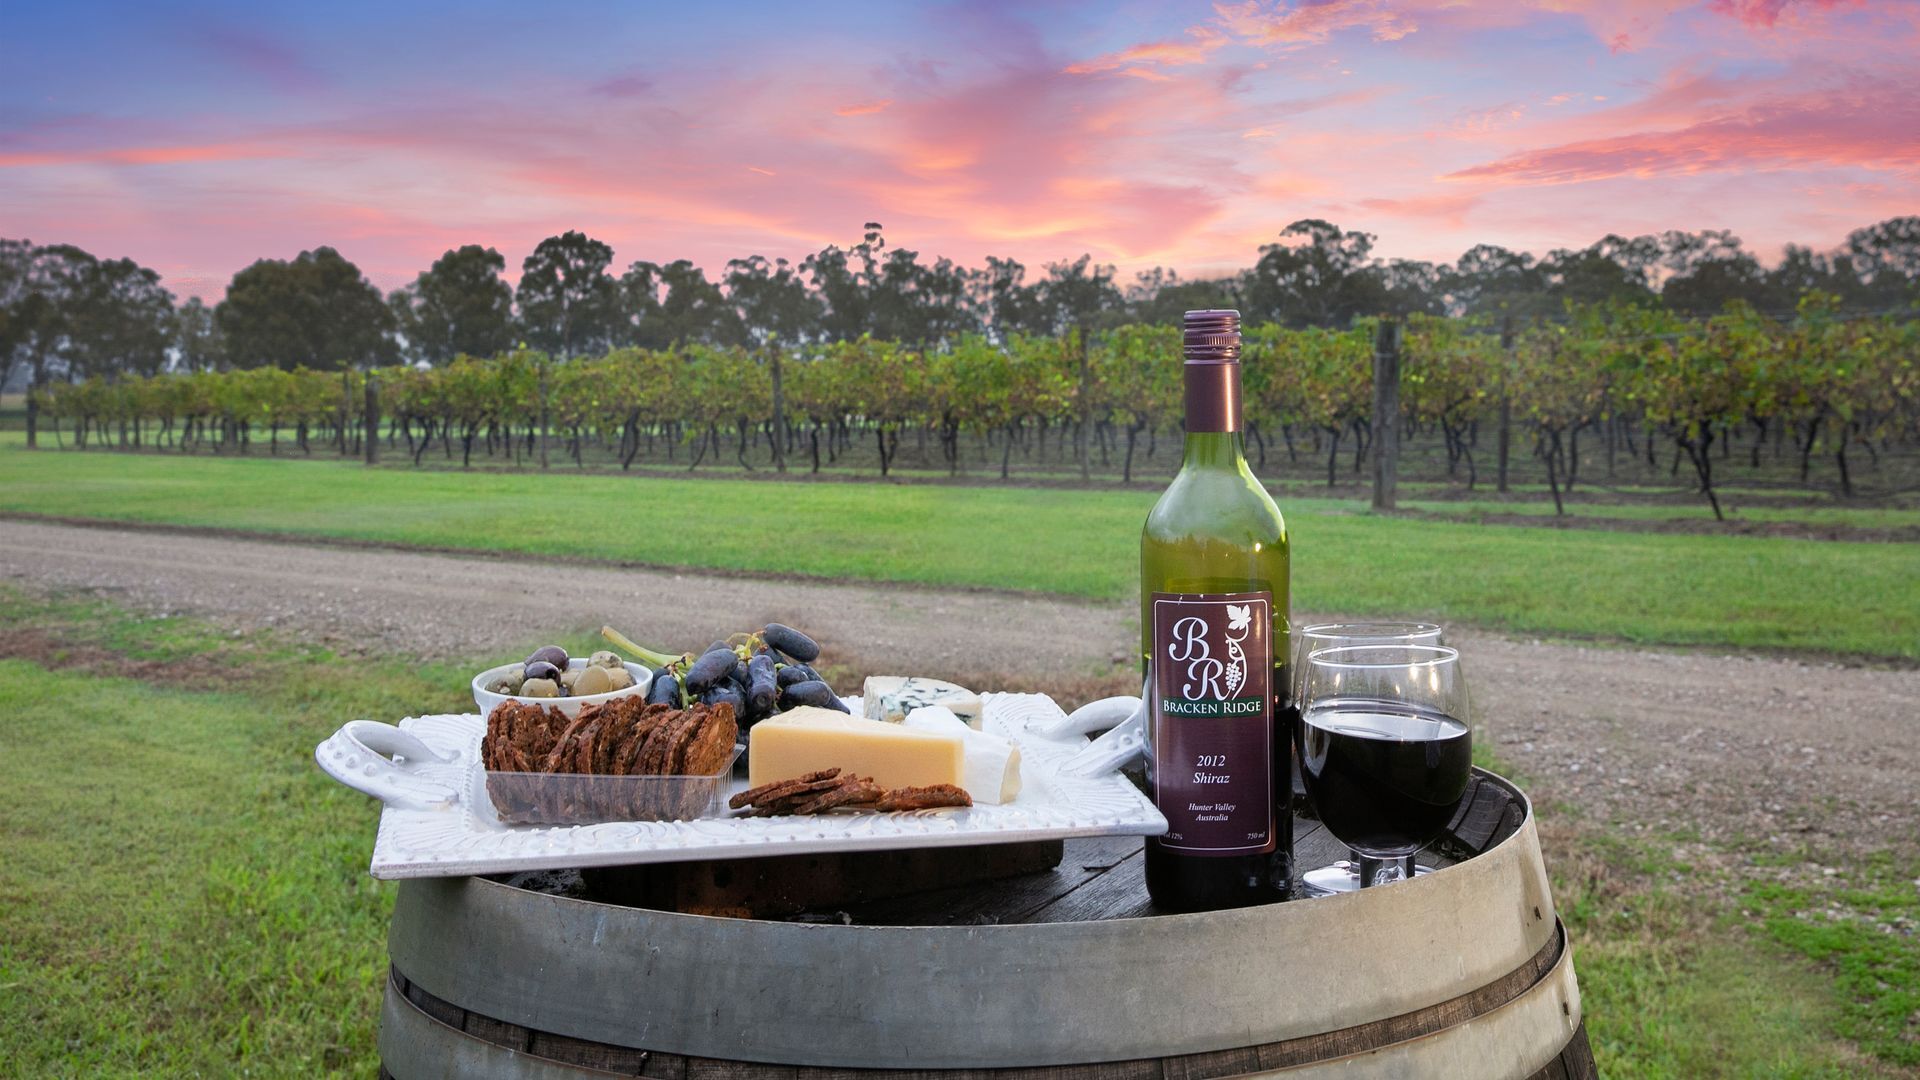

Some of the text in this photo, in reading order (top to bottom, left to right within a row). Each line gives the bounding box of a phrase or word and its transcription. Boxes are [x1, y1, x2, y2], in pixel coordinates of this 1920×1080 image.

[1162, 699, 1262, 714] BRACKEN RIDGE
[1196, 754, 1226, 767] 2012
[1192, 771, 1231, 784] Shiraz
[1188, 802, 1237, 813] Hunter Valley
[1195, 813, 1229, 822] Australia
[1247, 832, 1258, 840] 750
